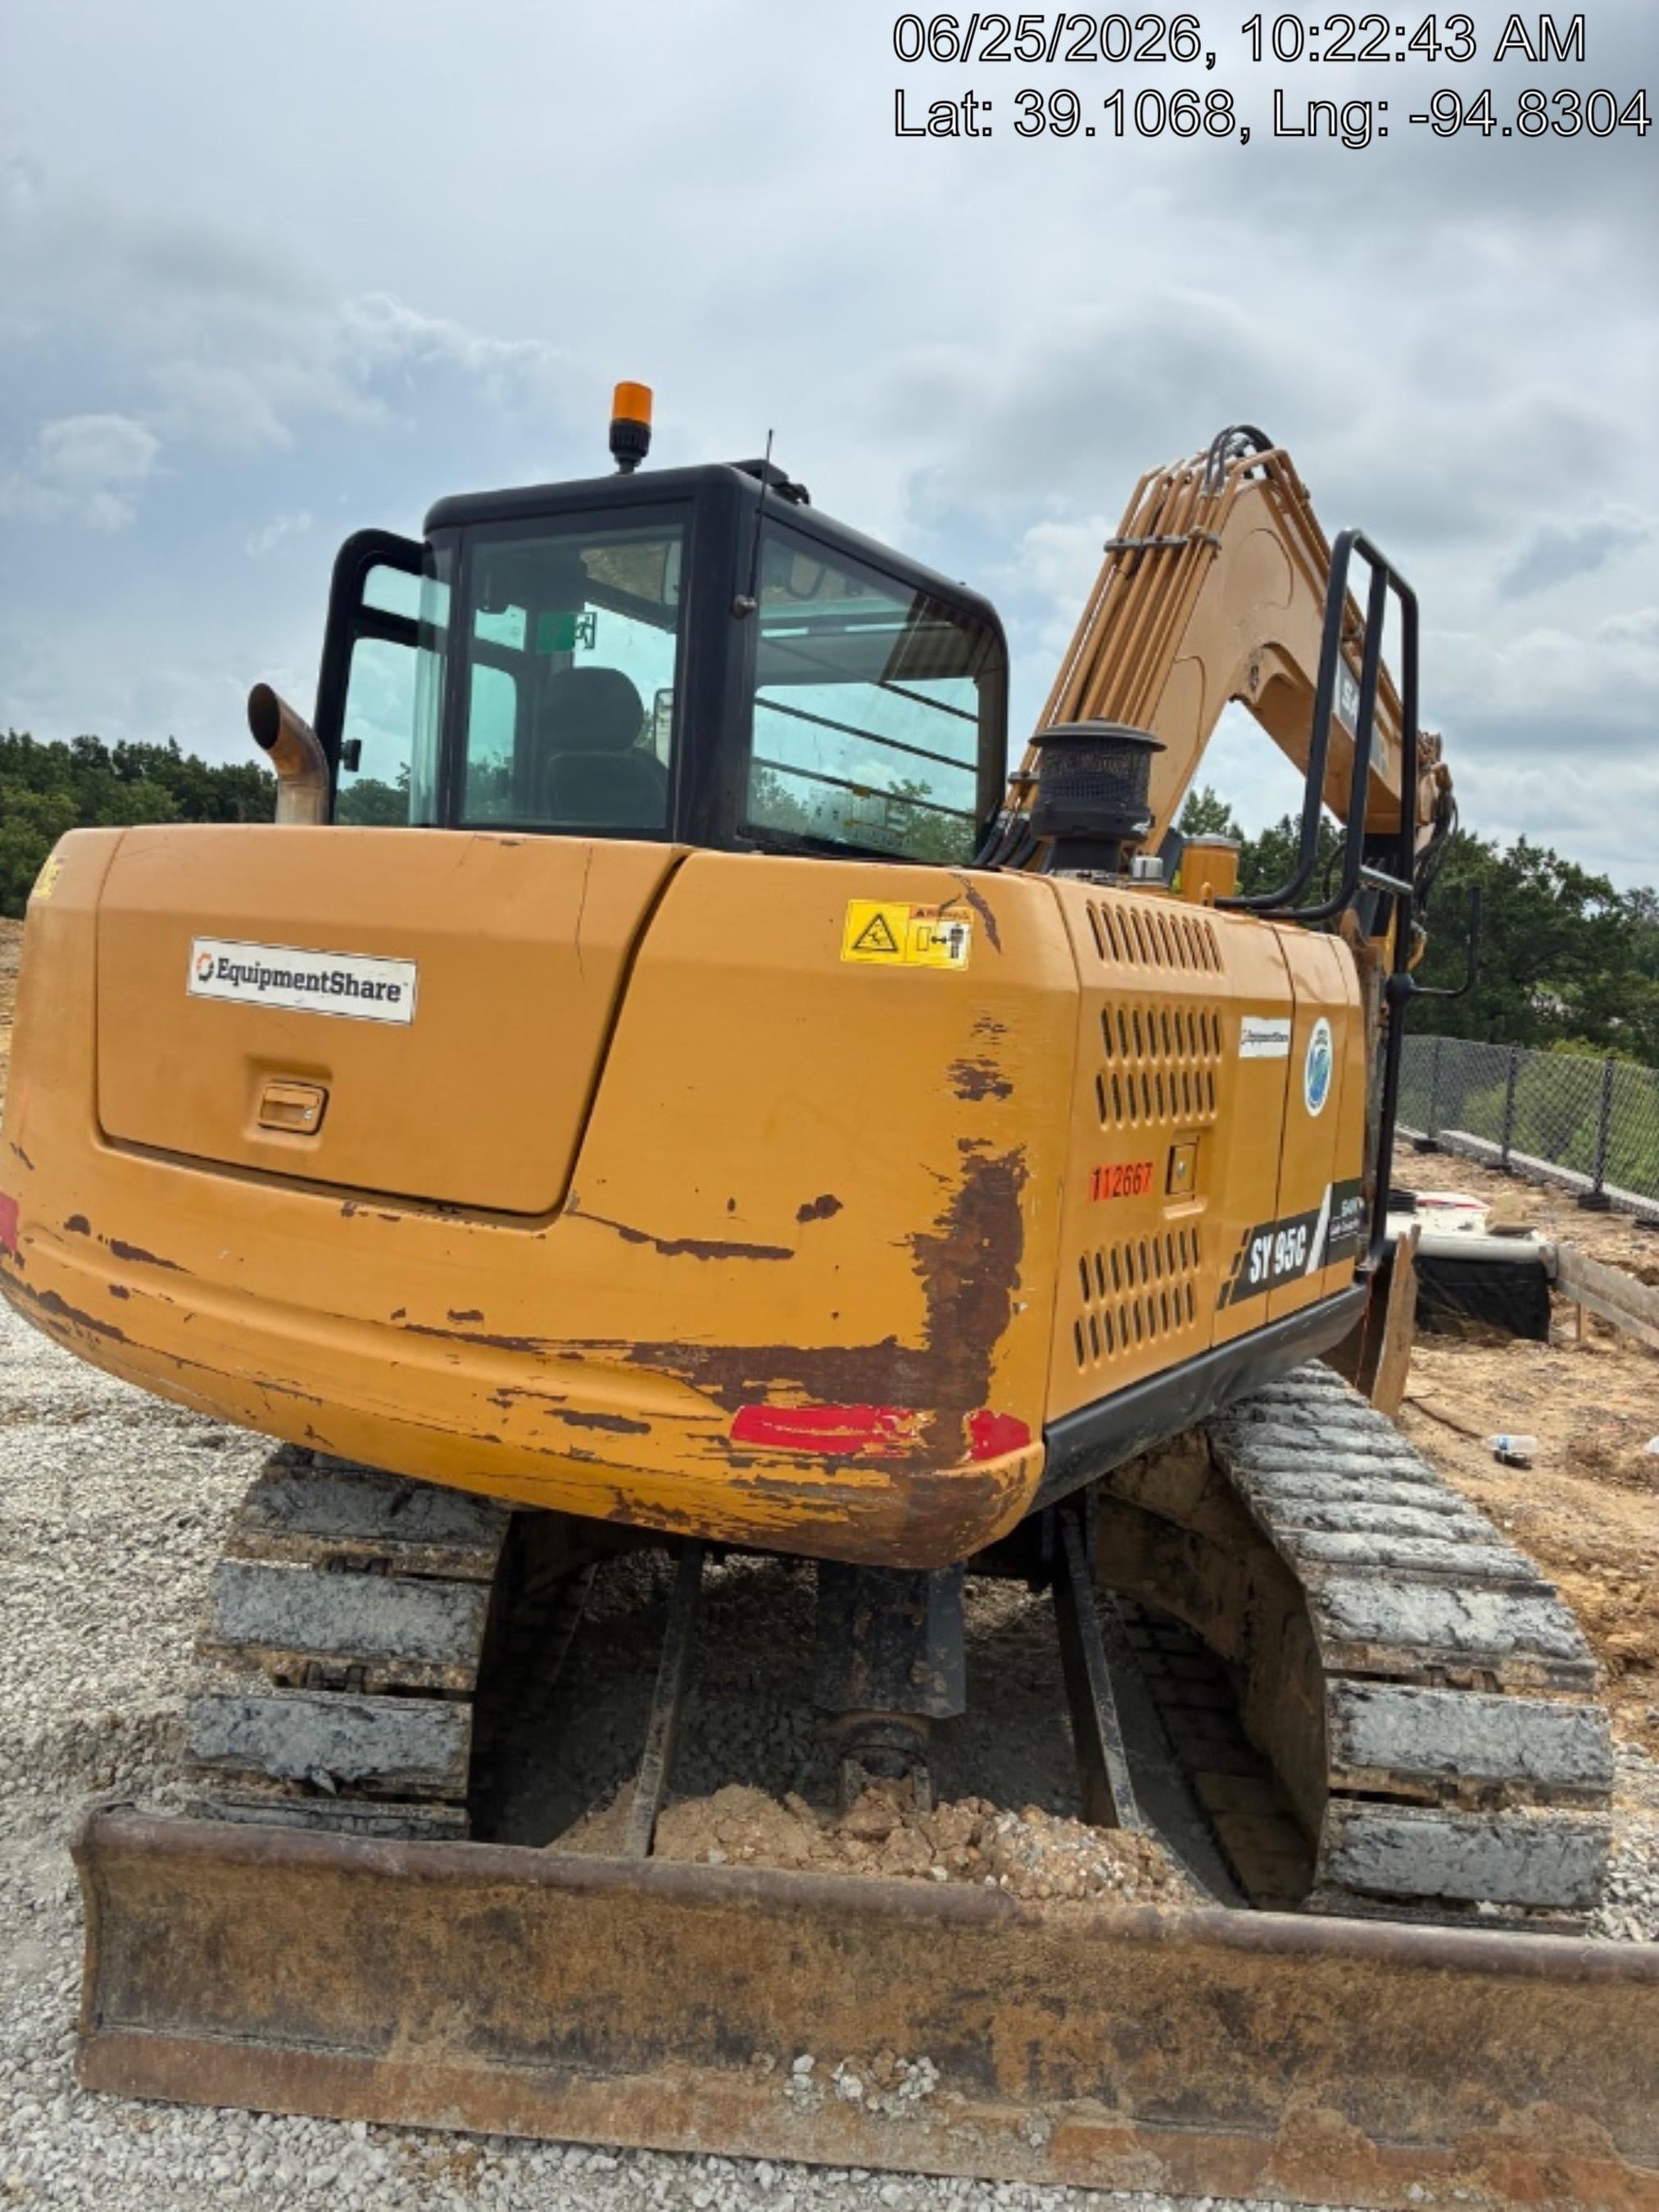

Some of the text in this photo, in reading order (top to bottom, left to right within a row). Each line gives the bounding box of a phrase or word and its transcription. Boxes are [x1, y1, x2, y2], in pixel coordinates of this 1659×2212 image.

[215, 957, 402, 1003] EquipmentShare
[1093, 1162, 1154, 1203] 112667
[1249, 1233, 1274, 1284] SY
[1275, 1224, 1307, 1275] 95C
